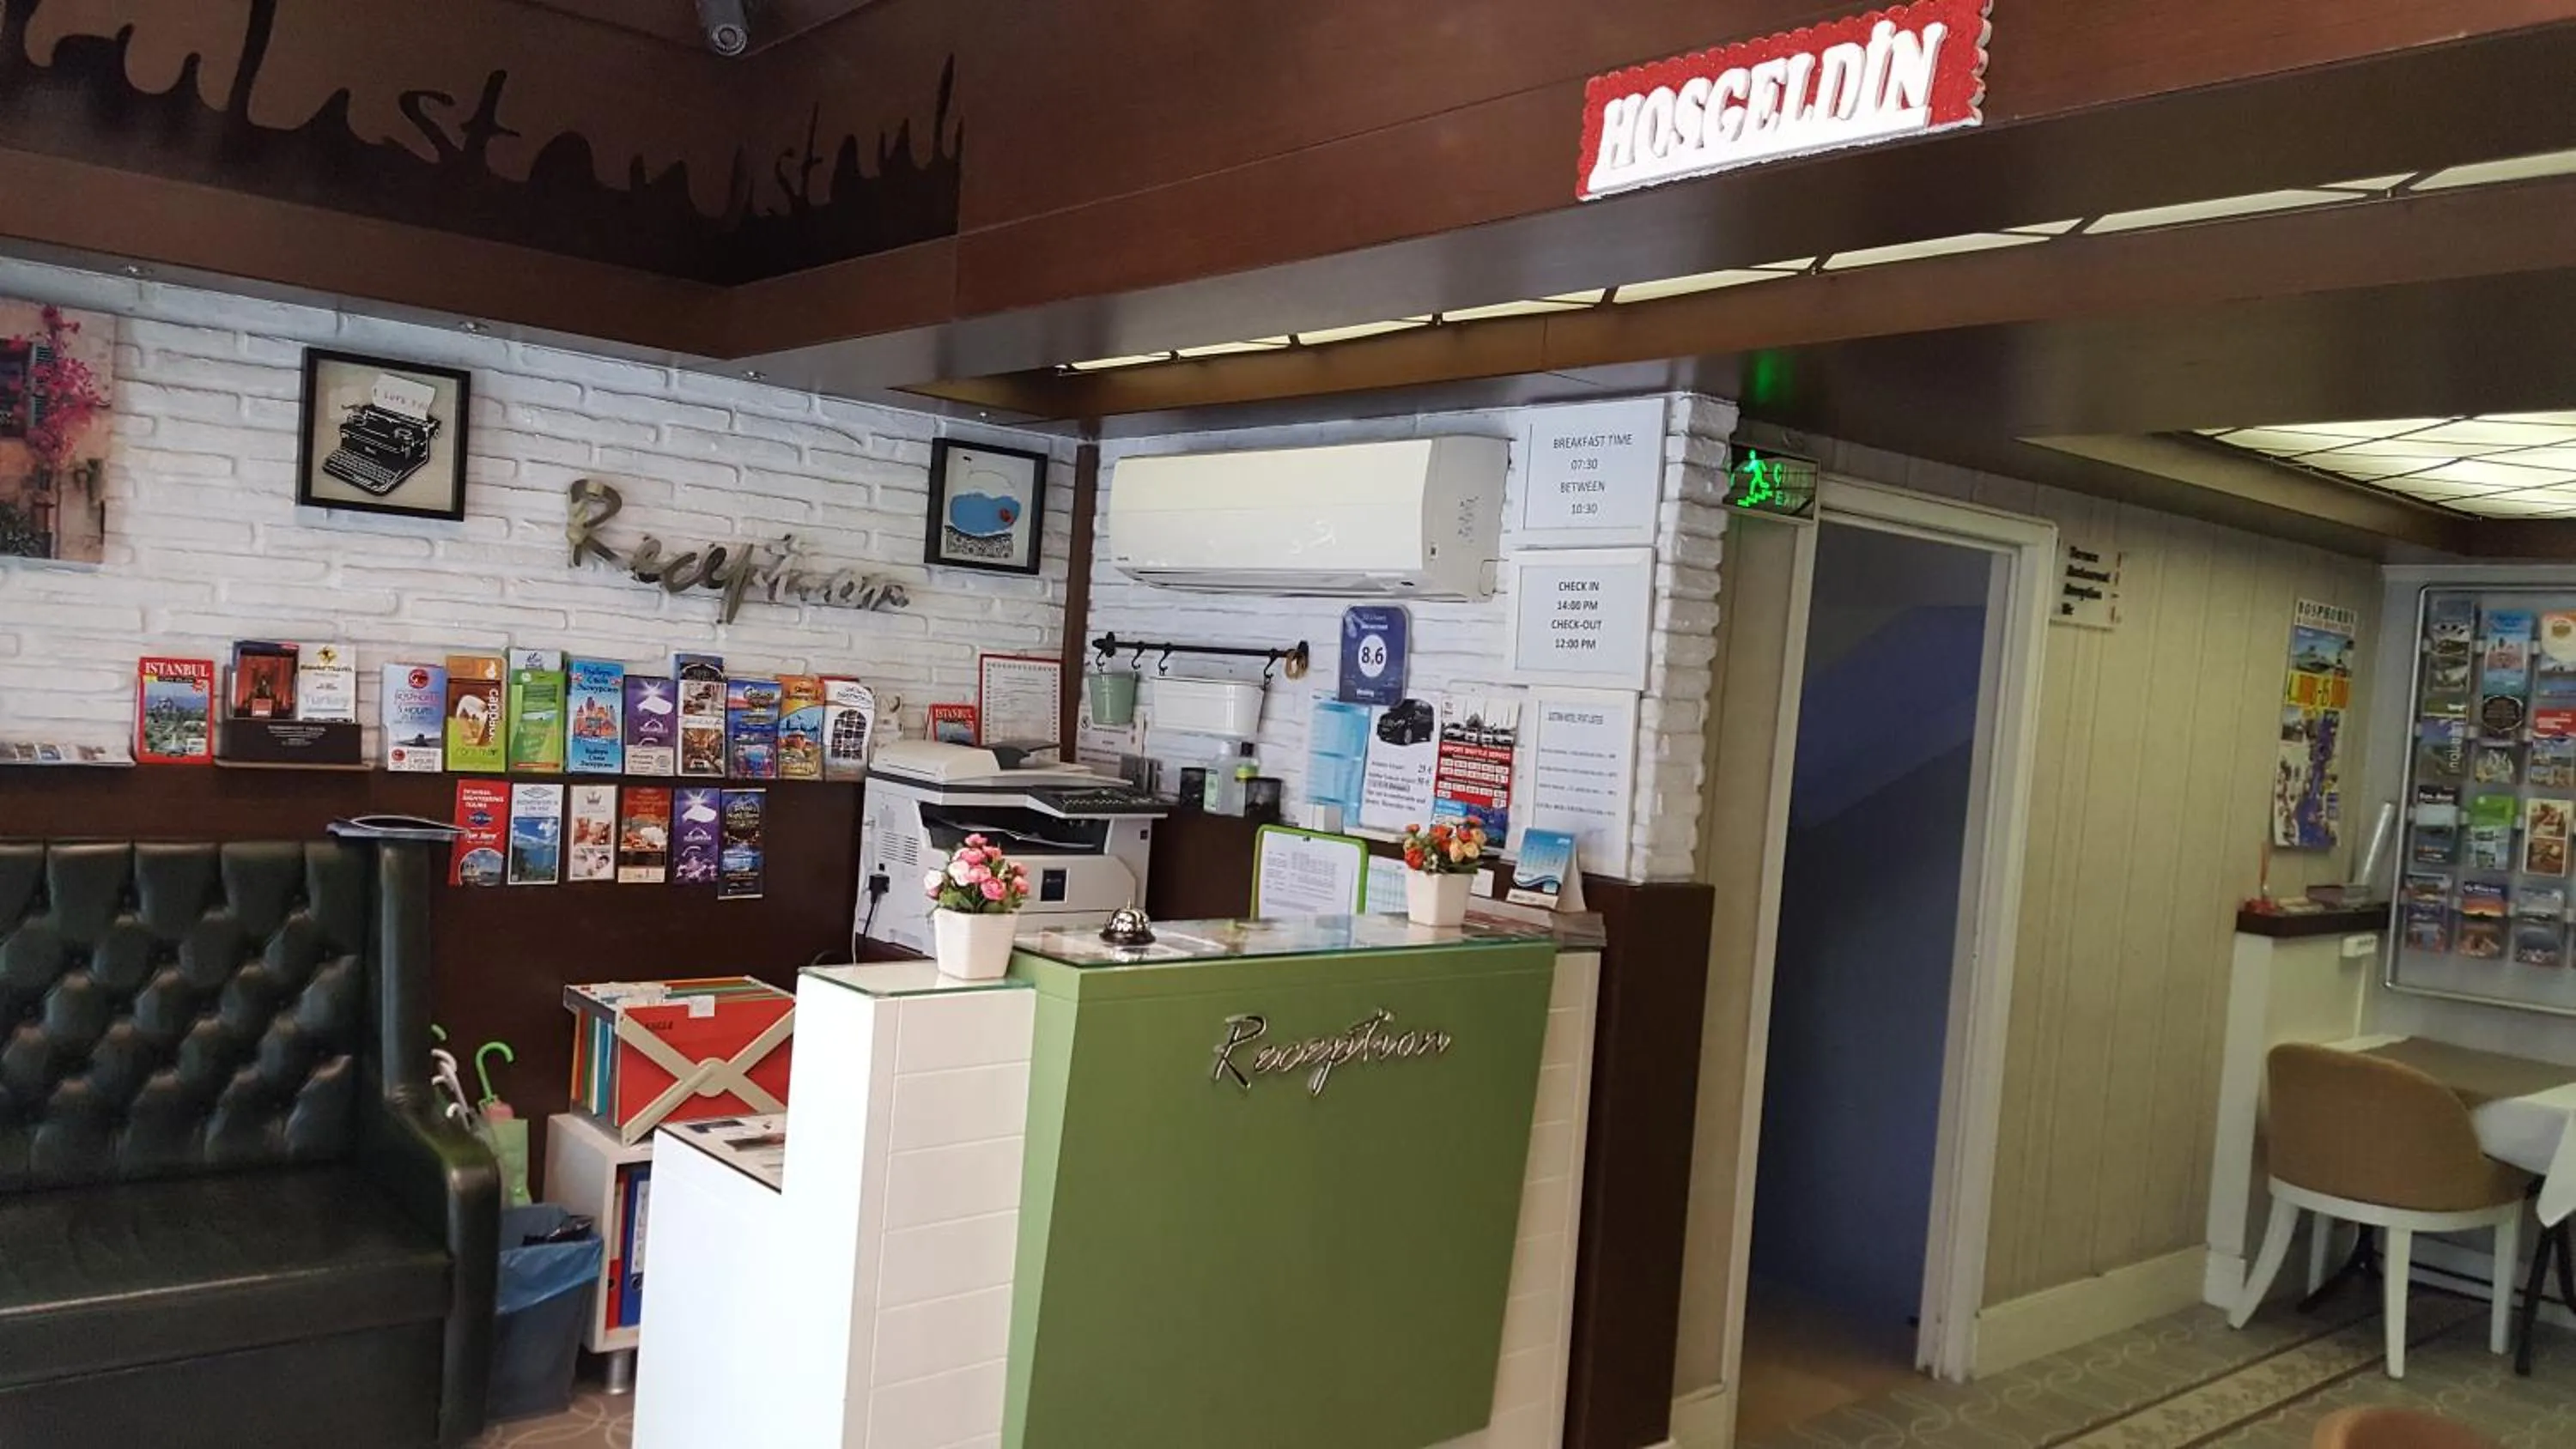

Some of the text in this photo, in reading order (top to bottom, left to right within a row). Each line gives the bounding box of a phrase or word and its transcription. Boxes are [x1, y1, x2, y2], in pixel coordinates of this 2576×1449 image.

[1552, 433, 1633, 449] BREAKFAST TIME
[1570, 458, 1598, 470] 07:30
[1559, 480, 1606, 494] BETWEEN
[1571, 503, 1598, 515] 10:30
[1558, 580, 1601, 592] CHECK IN
[1556, 600, 1599, 611] 14:00 PM
[1550, 618, 1603, 631] CHECK-OUT
[1554, 638, 1597, 650] 12:00 PM
[144, 661, 210, 679] ISTANBUL
[1212, 1008, 1452, 1098] Reception
